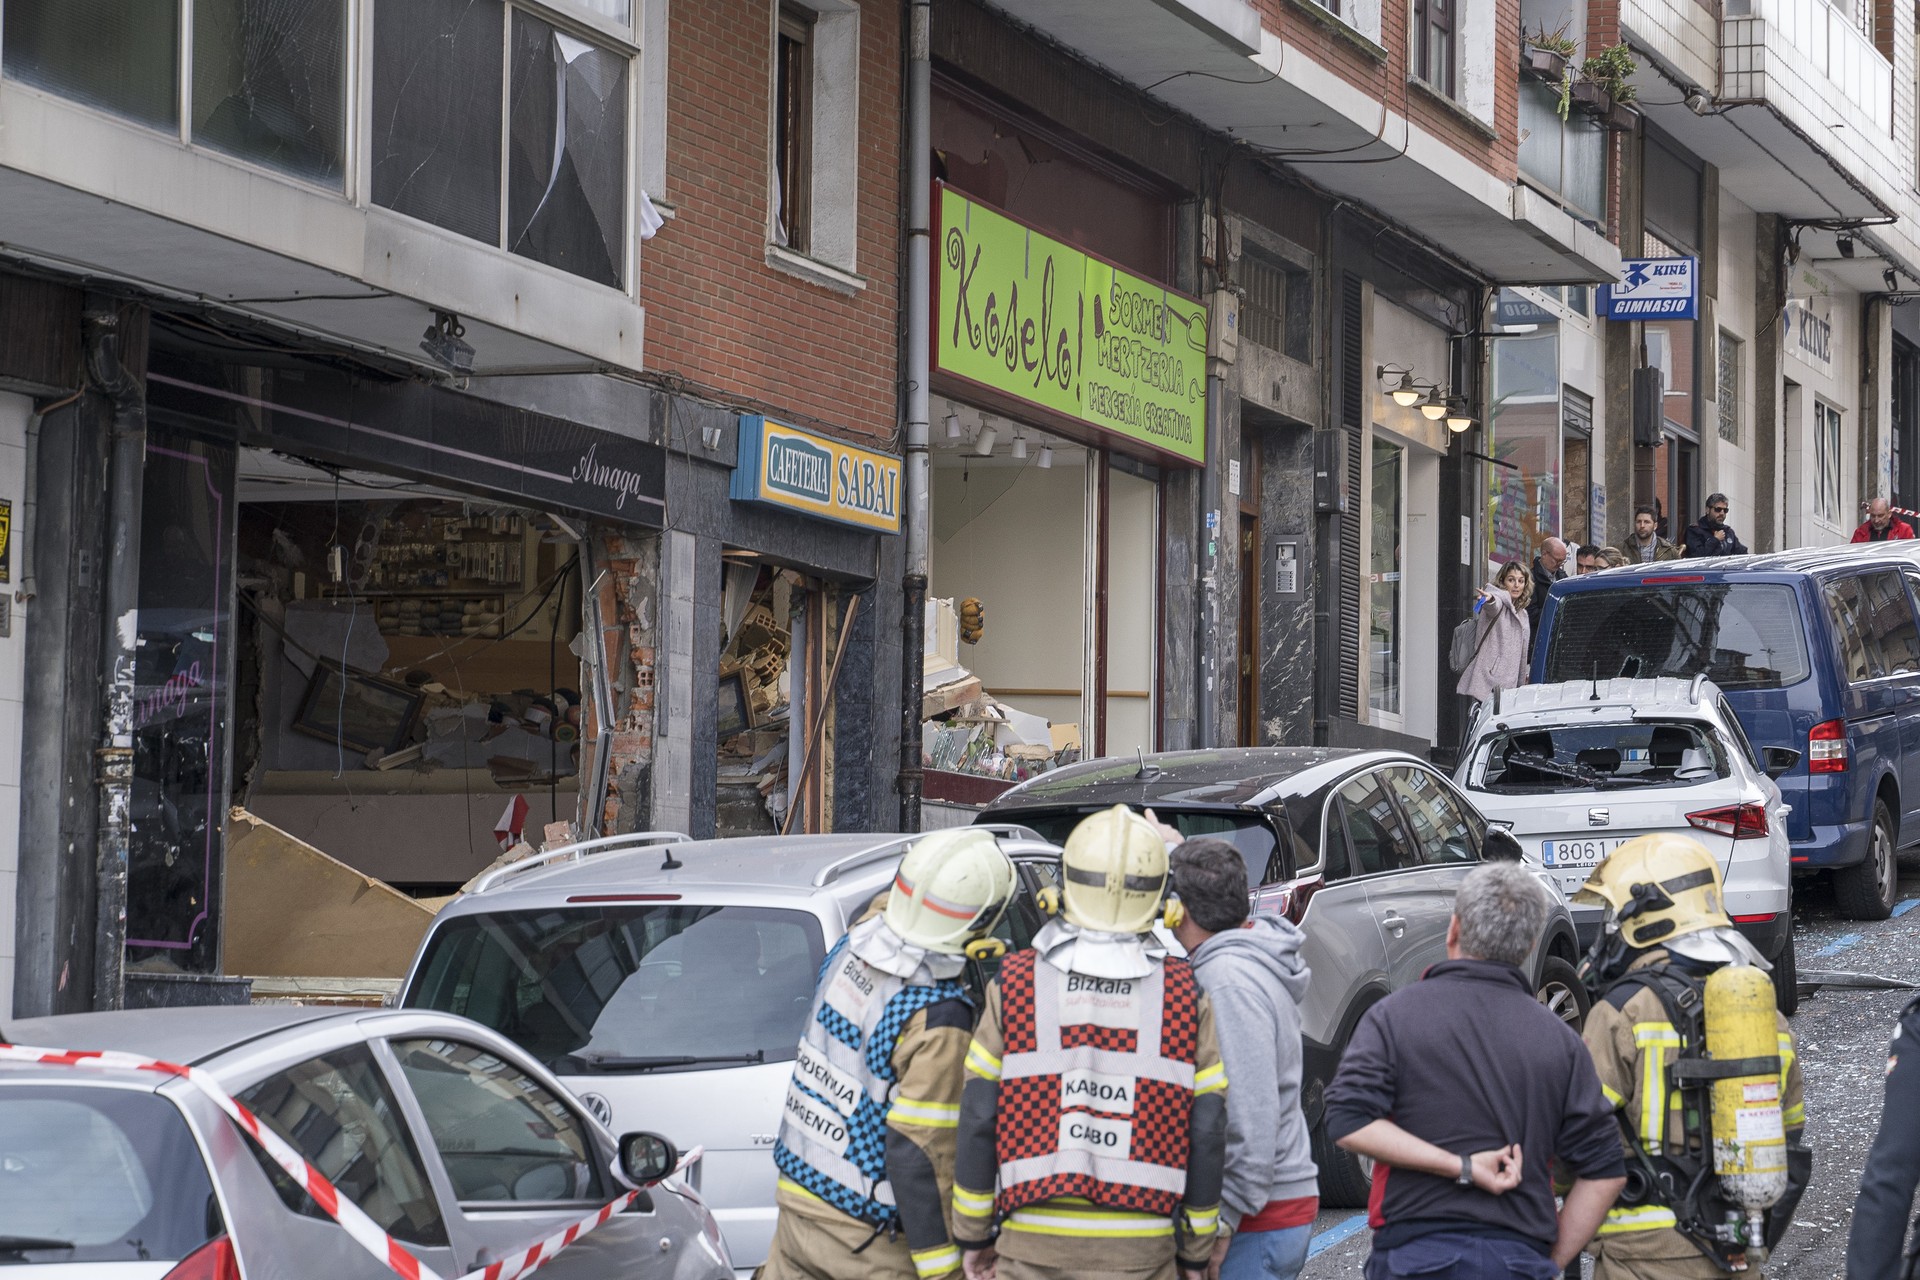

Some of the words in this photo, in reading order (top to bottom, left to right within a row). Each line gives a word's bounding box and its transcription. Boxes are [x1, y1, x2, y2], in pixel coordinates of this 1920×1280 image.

[1653, 262, 1687, 276] KINÉ
[1109, 283, 1172, 344] SORMEN
[1614, 299, 1687, 313] GIMNASIO
[1098, 330, 1184, 396] MERTZERIA
[1089, 382, 1142, 427] MERCERÍA
[1143, 402, 1192, 444] CREATIVA
[572, 442, 641, 511] Arnaga
[769, 443, 829, 495] CAFETERIA
[837, 454, 897, 520] SABAI
[134, 660, 204, 727] rnaga
[1559, 841, 1606, 860] 8061
[1065, 1079, 1127, 1101] KABOA
[1069, 1123, 1117, 1146] CABO
